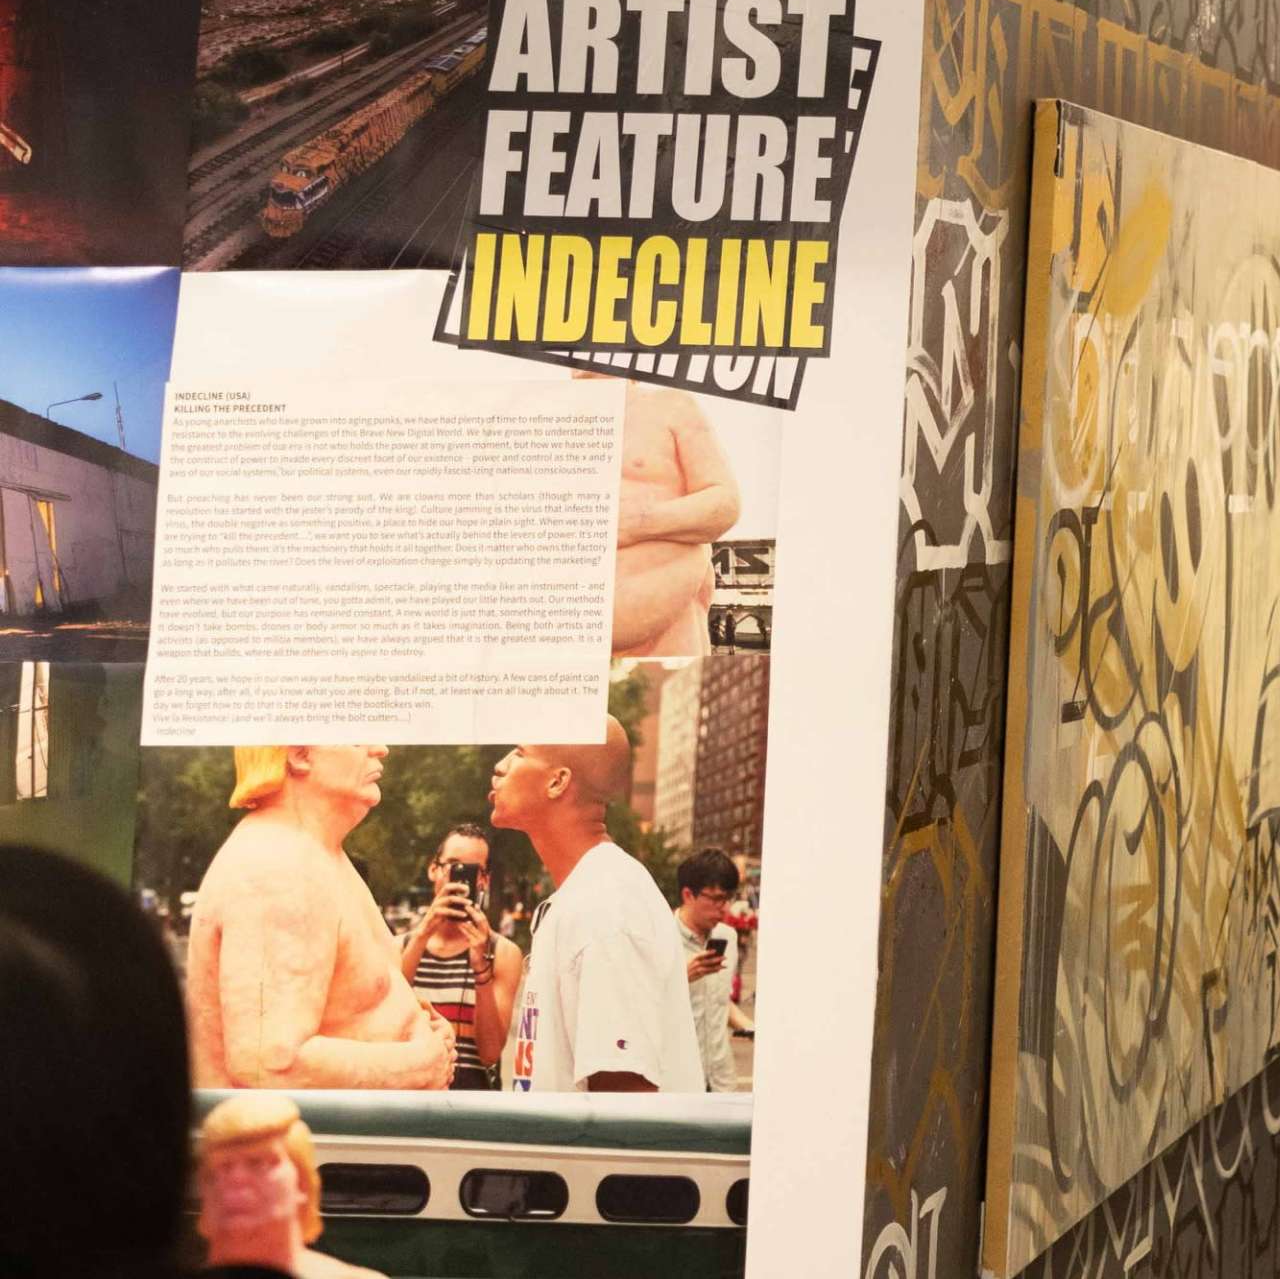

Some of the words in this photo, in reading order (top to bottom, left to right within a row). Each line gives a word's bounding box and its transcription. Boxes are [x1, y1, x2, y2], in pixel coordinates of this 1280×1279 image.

[479, 110, 837, 223] FEATURE
[467, 233, 829, 349] INDECLINE
[175, 392, 224, 400] INDECLINE
[225, 392, 251, 401] (USA)
[232, 404, 285, 412] PRECEDENT
[496, 415, 517, 423] time
[528, 415, 553, 423] refine
[555, 415, 571, 423] and
[572, 415, 598, 424] adapt
[481, 428, 502, 436] have
[504, 430, 532, 438] grown
[544, 428, 594, 436] understand
[513, 441, 528, 449] but
[601, 442, 613, 450] up
[588, 453, 605, 461] and
[498, 492, 534, 500] scholars
[494, 505, 502, 513] is
[504, 505, 519, 513] the
[521, 505, 542, 513] virus
[544, 505, 562, 513] that
[479, 518, 487, 526] in
[488, 518, 512, 528] plain
[539, 518, 563, 526] When
[493, 531, 508, 539] the
[510, 531, 535, 539] levers
[478, 544, 484, 552] it
[576, 543, 607, 553] factory
[483, 557, 493, 566] by
[495, 557, 535, 566] updating
[530, 582, 578, 590] instrument
[587, 582, 604, 590] and
[499, 595, 527, 603] hearts
[547, 595, 564, 603] Our
[565, 595, 604, 603] methods
[499, 608, 546, 618] something
[547, 608, 581, 618] entirely
[505, 622, 530, 631] Being
[556, 621, 583, 629] artists
[585, 621, 602, 629] and
[500, 636, 536, 644] greatest
[577, 634, 584, 642] It
[586, 634, 594, 642] is
[548, 673, 558, 681] of
[559, 673, 581, 683] paint
[517, 686, 542, 696] laugh
[543, 686, 569, 694] about
[582, 686, 598, 694] The
